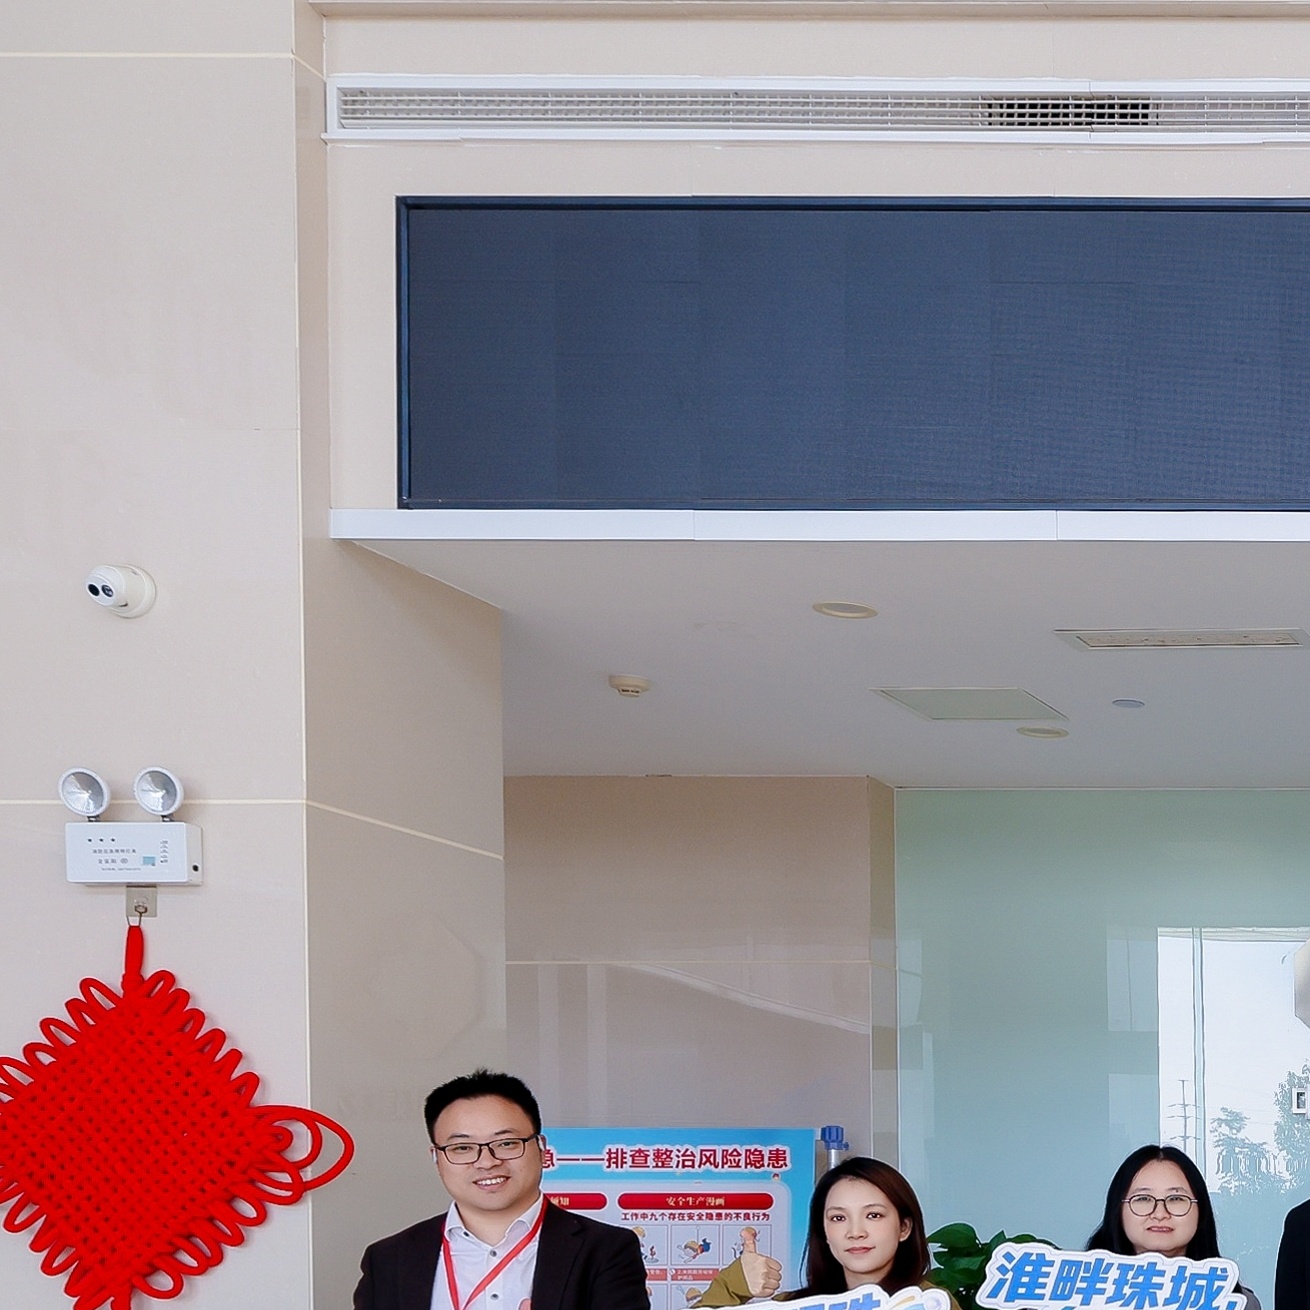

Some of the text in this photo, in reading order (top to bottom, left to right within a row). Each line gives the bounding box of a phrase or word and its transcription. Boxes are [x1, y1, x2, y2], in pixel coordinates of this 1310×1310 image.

[621, 1212, 770, 1222] 工作中九个存在安全隐患的不良行为
